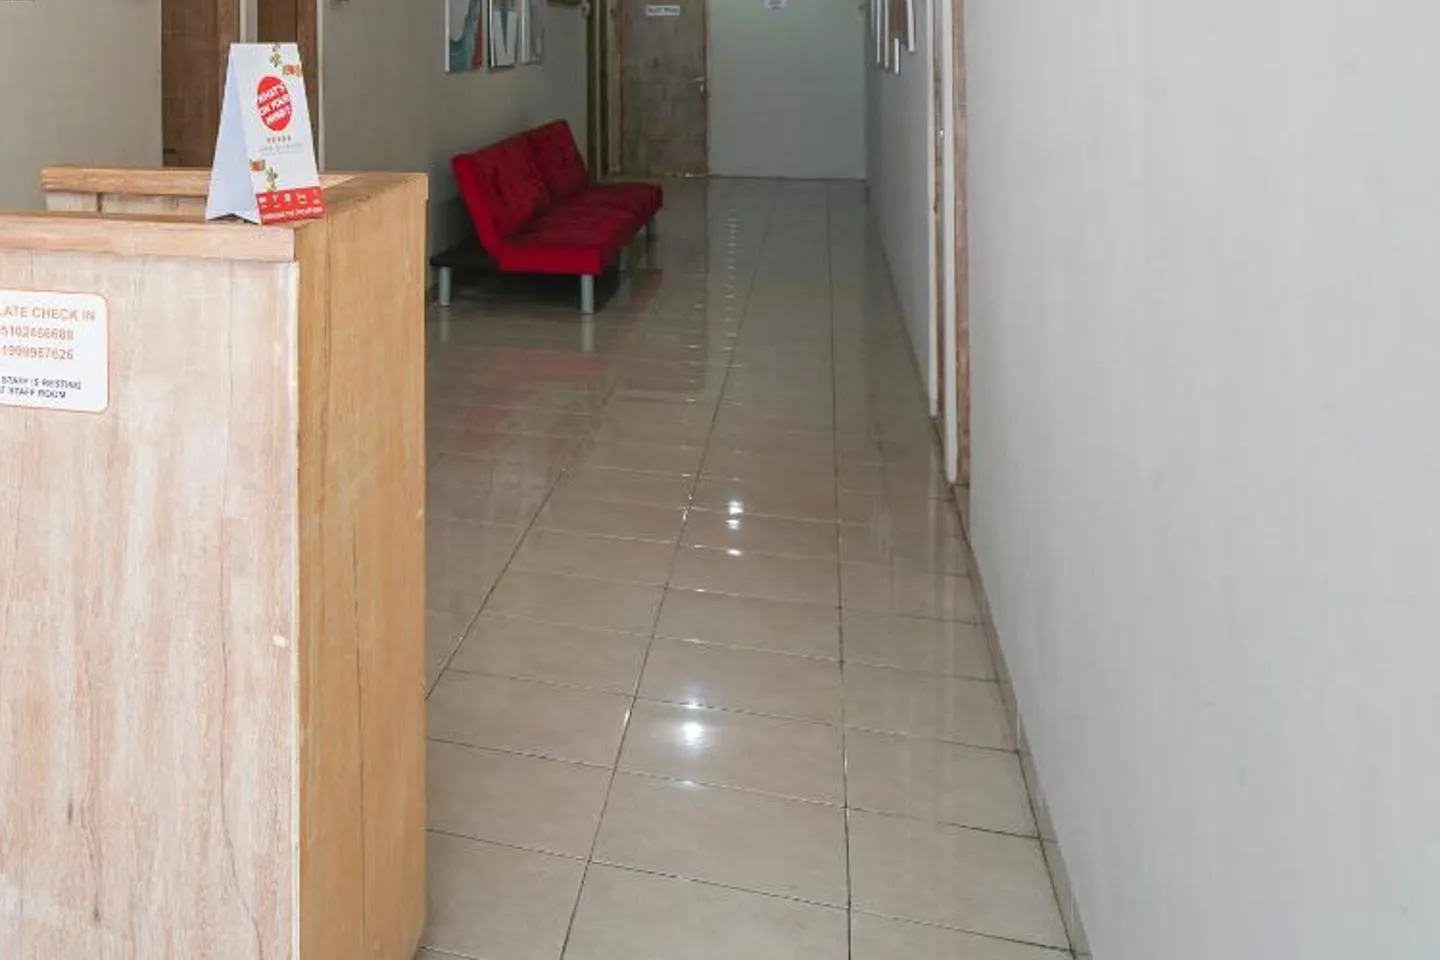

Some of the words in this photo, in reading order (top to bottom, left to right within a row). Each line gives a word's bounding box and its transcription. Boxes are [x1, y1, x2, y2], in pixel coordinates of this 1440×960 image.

[32, 306, 78, 321] CHECK
[81, 309, 96, 321] IN
[1, 375, 28, 385] STAFF
[30, 377, 40, 386] IS
[41, 378, 82, 390] RESTING
[8, 387, 36, 396] STAFF
[37, 389, 66, 398] ROOM
